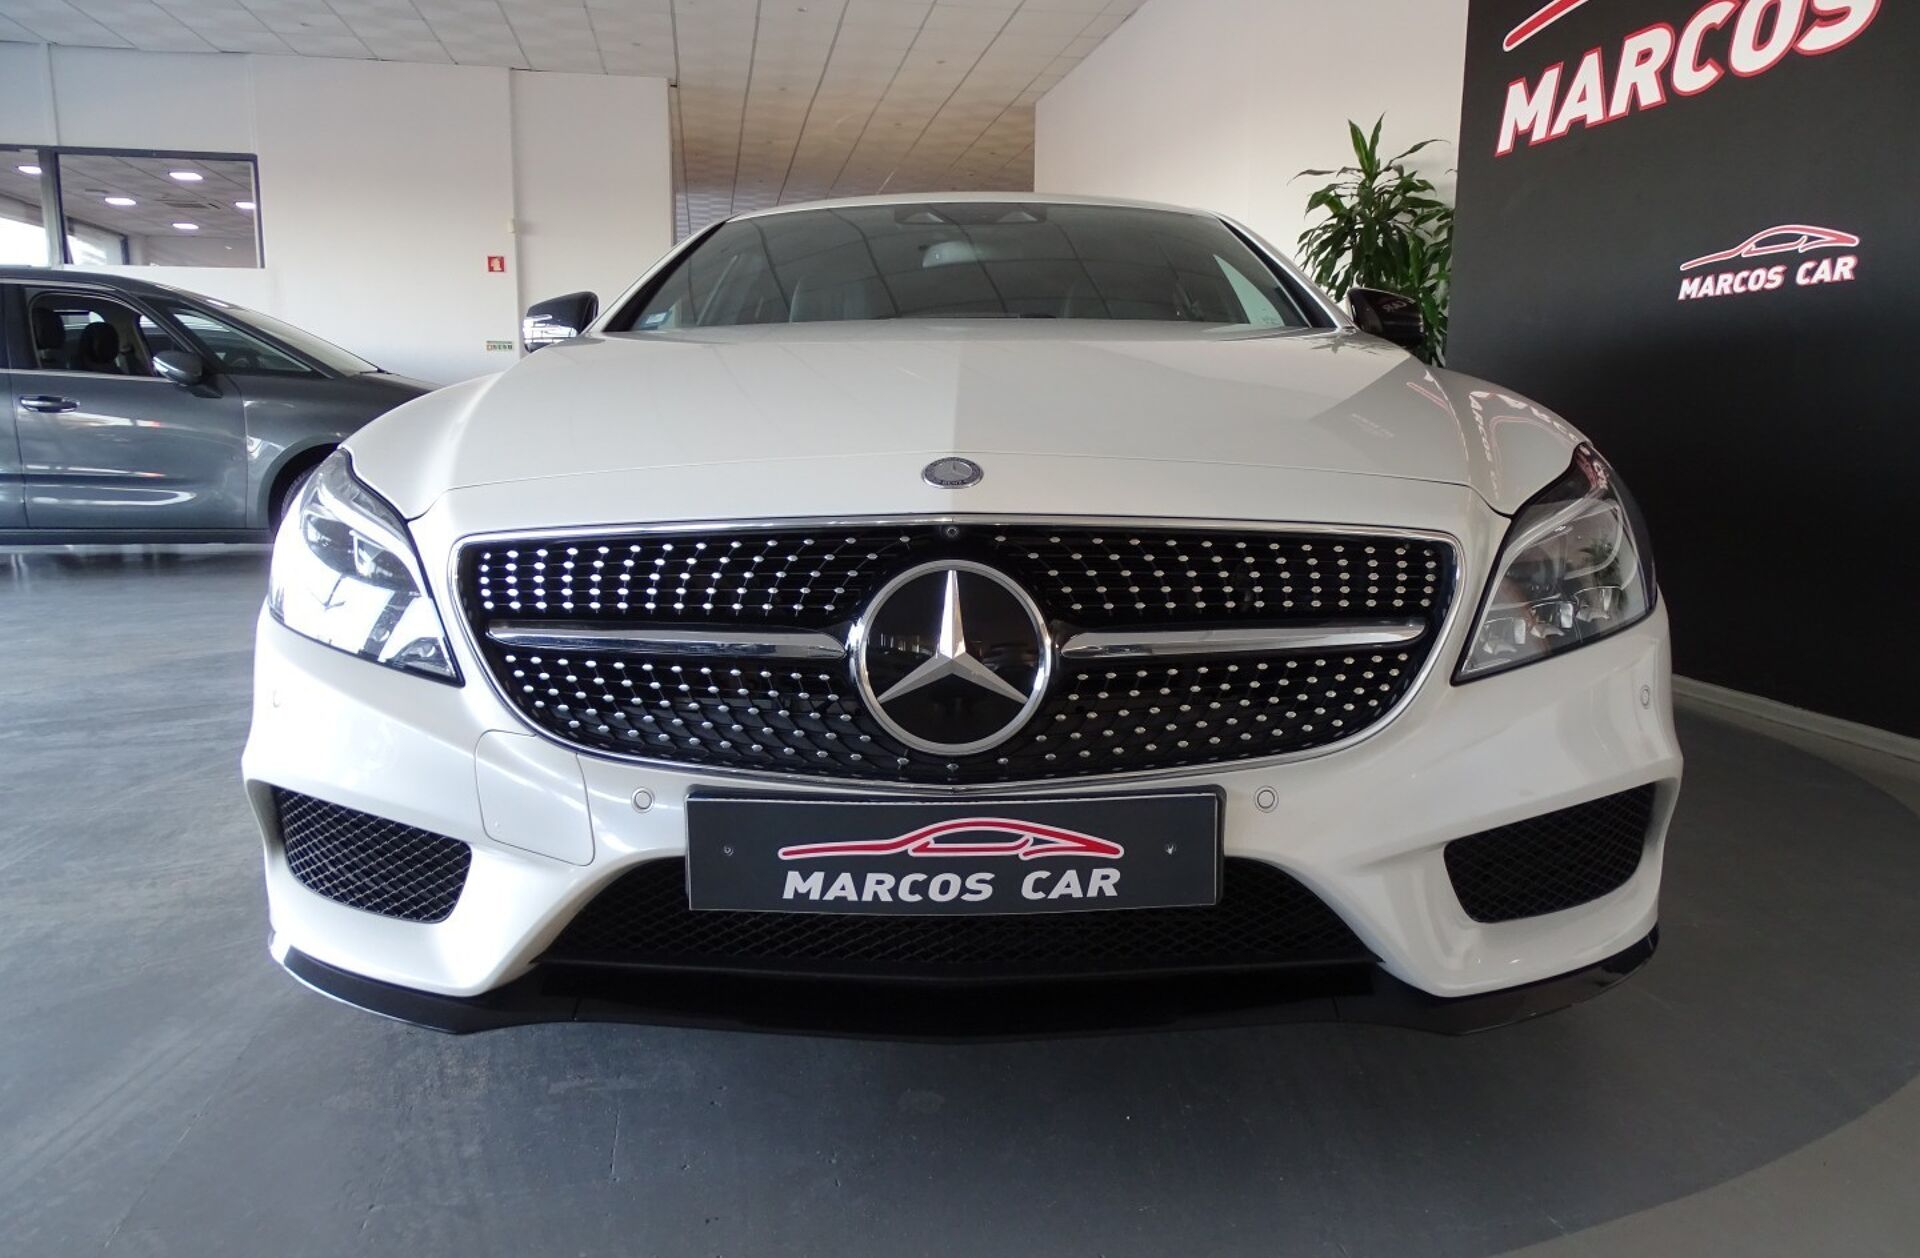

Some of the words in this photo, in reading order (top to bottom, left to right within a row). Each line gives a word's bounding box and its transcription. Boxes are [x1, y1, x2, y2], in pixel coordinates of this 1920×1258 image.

[1496, 0, 1882, 156] MARCOS
[1677, 265, 1787, 300] MARCOS
[1795, 255, 1859, 287] CAR
[782, 870, 995, 902] MARCOS
[1021, 867, 1121, 900] CAR
